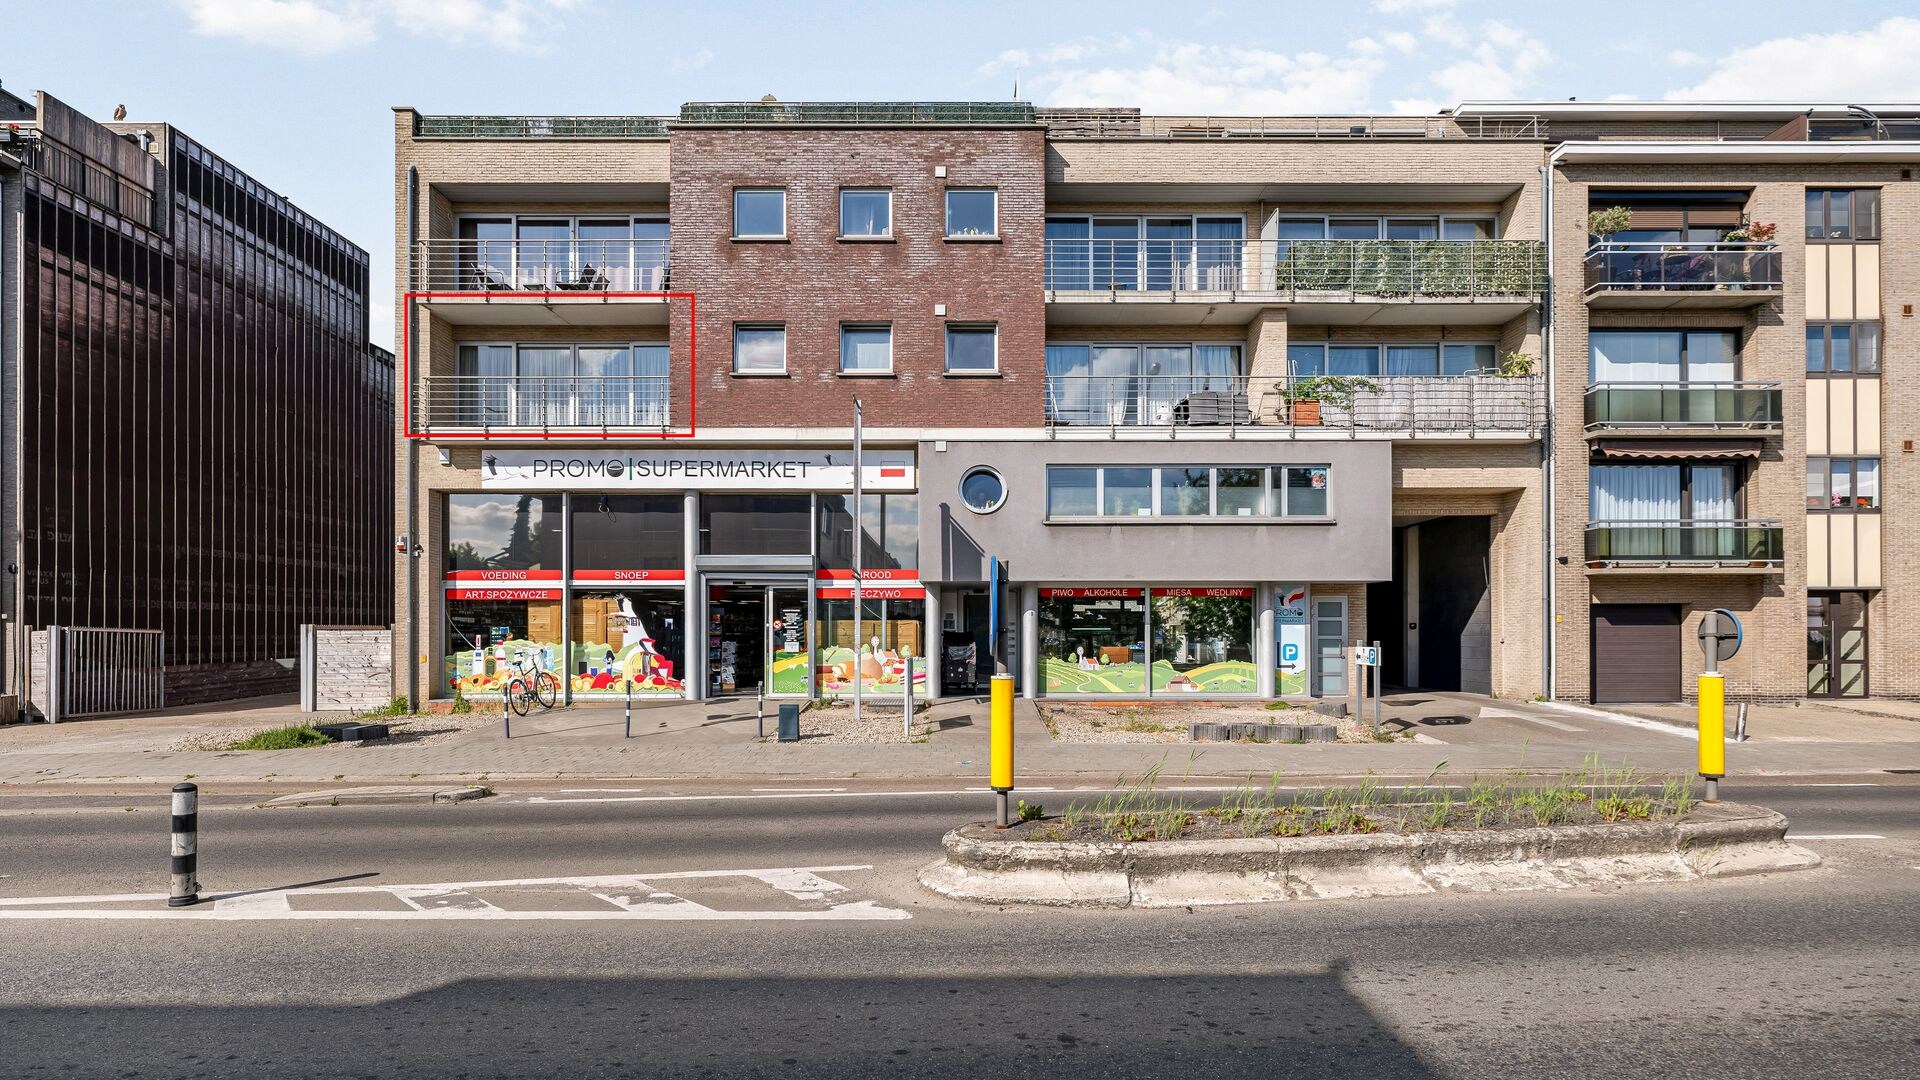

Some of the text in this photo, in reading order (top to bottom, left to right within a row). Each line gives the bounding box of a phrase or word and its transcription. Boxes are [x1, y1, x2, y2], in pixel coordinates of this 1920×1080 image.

[533, 459, 811, 478] PROMO SUPERMARKET
[480, 571, 527, 580] VOEDING
[614, 571, 649, 580] SNOEP
[850, 590, 901, 598] PECZYWO
[1051, 588, 1128, 597] PIWO ALKOHOLE
[1275, 608, 1303, 616] ROMO
